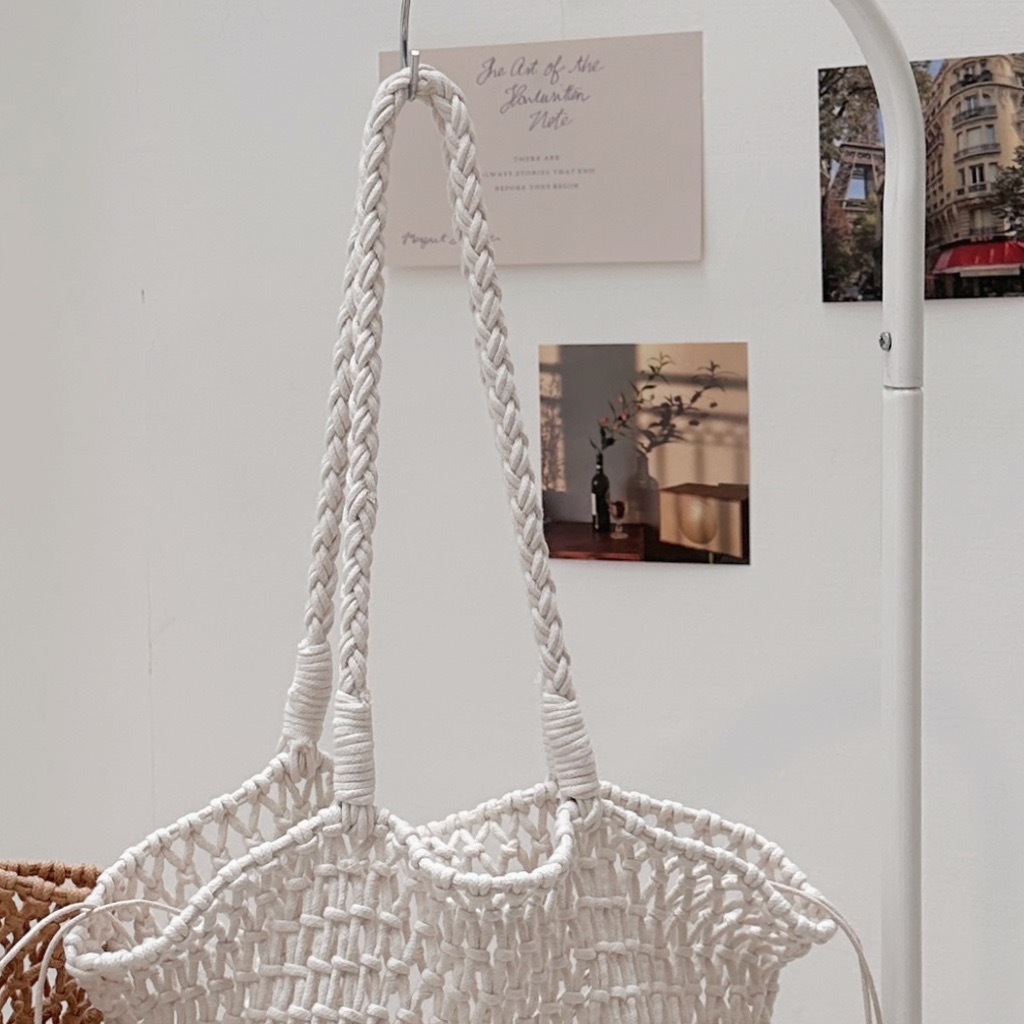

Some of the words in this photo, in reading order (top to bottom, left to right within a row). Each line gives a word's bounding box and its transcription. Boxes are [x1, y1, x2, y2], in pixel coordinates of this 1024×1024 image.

[476, 56, 506, 86] The
[510, 56, 538, 77] Art
[543, 54, 565, 85] of
[568, 54, 605, 74] the
[528, 108, 573, 132] Note
[543, 154, 561, 162] ARE
